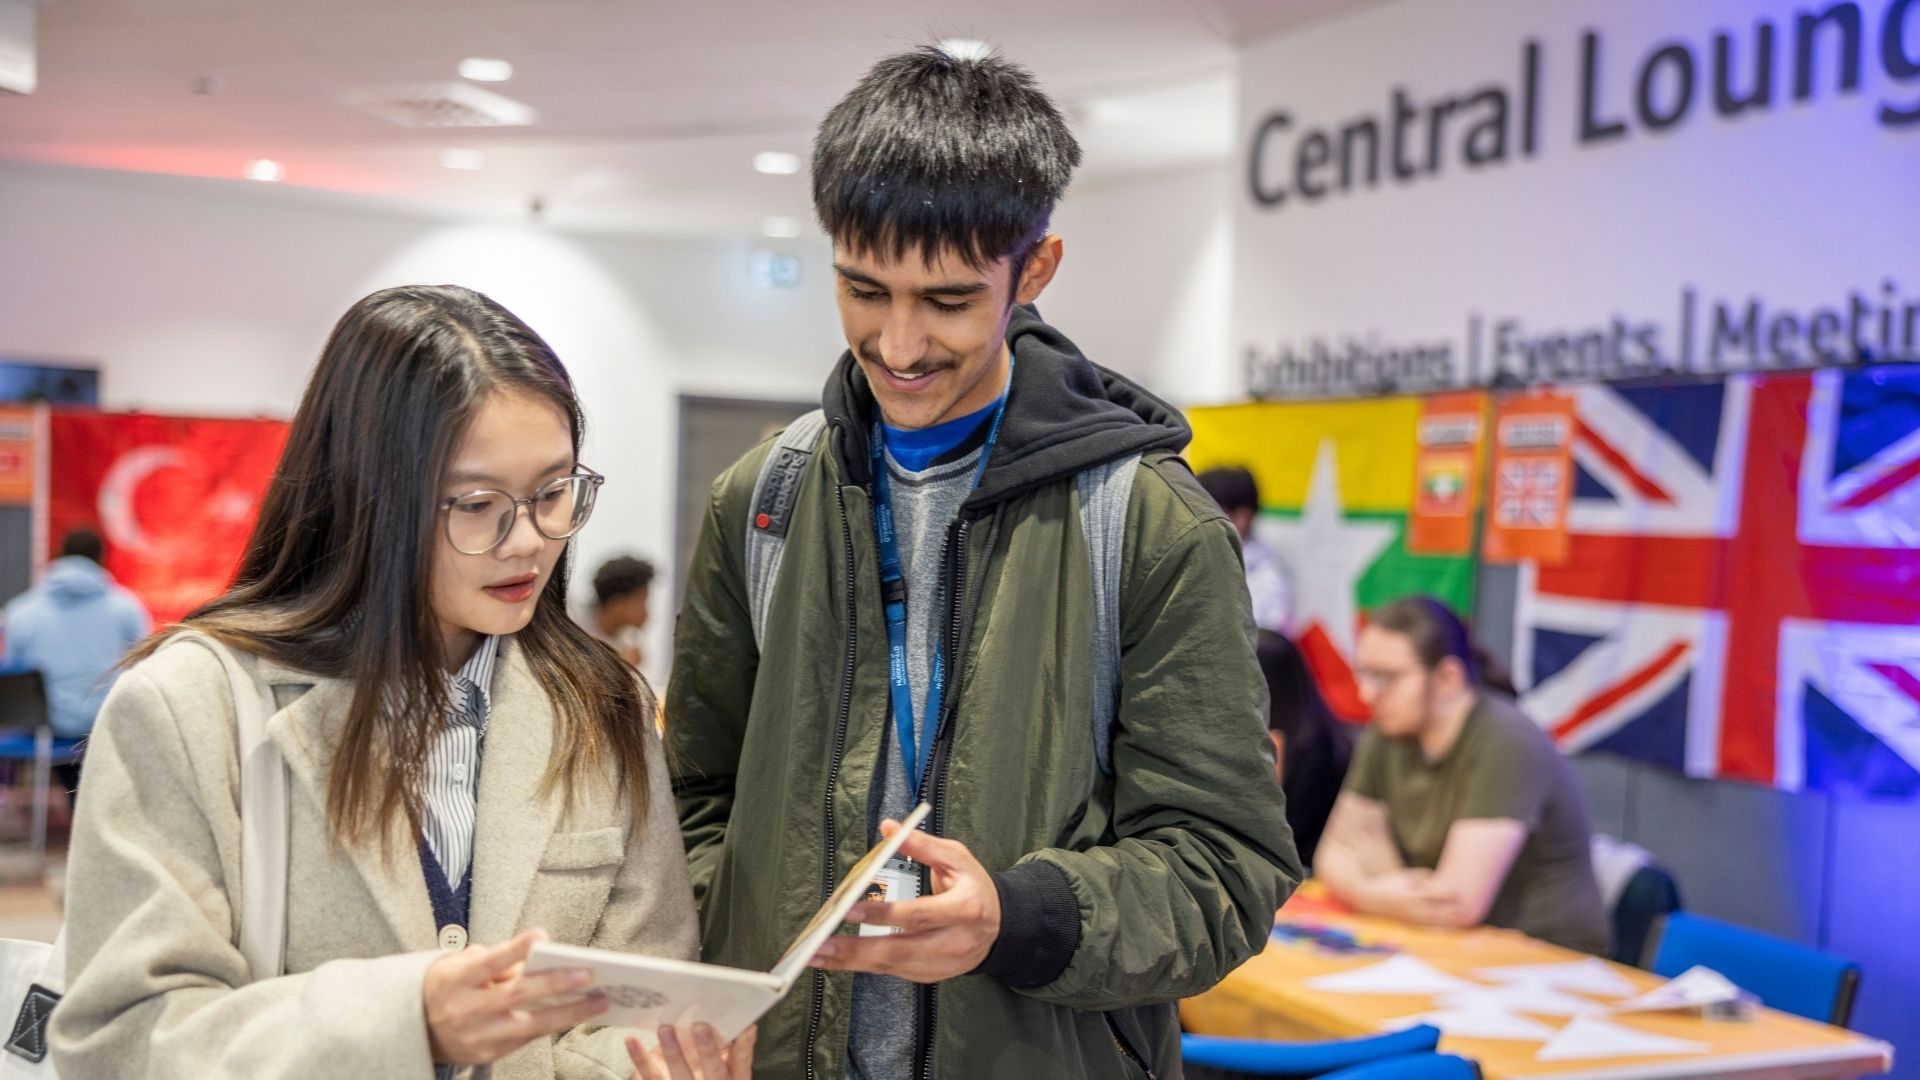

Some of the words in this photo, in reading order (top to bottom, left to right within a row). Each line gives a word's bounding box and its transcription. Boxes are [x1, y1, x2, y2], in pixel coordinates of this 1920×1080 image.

[1248, 40, 1538, 208] Central
[1577, 0, 1920, 145] Loung
[1495, 317, 1660, 384] Events
[770, 454, 806, 526] Superdry
